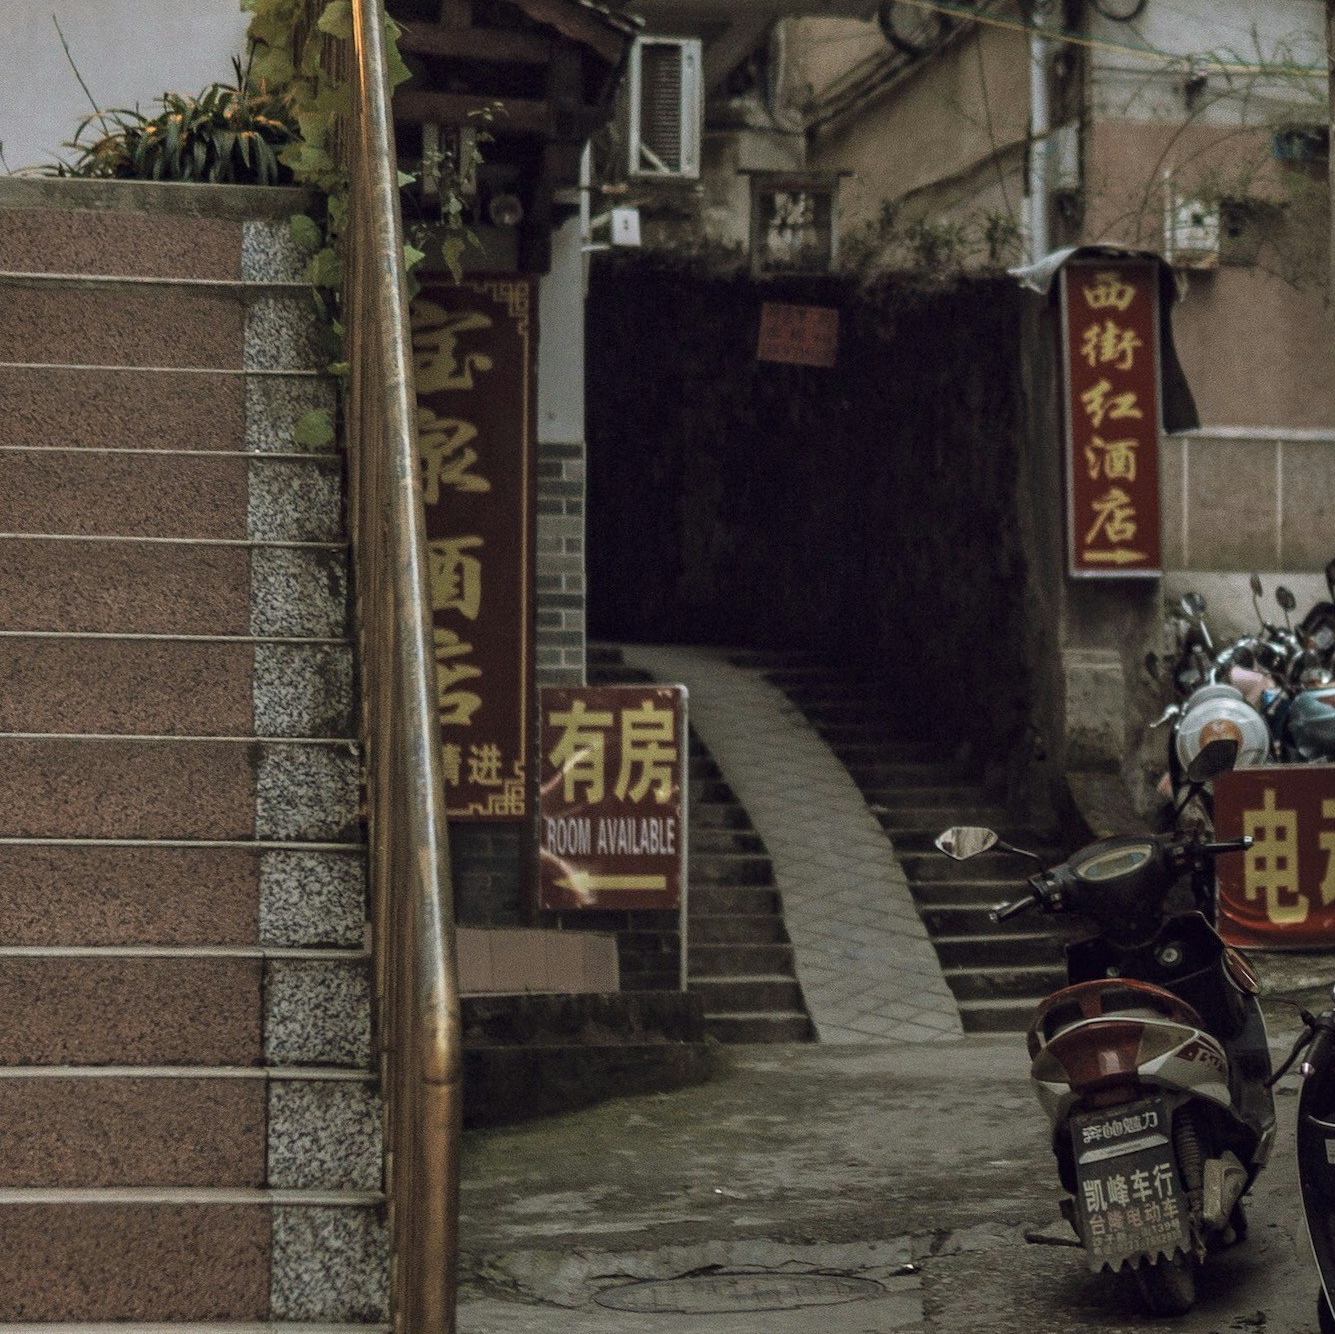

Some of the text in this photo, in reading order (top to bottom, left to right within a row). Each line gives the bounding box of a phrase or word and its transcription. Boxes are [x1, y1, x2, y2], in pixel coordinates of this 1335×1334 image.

[1079, 269, 1145, 545] 西街红酒店
[548, 699, 680, 807] 有房
[547, 817, 678, 856] ROOM AVAILABLE
[1083, 1162, 1175, 1214] 凯峰车行
